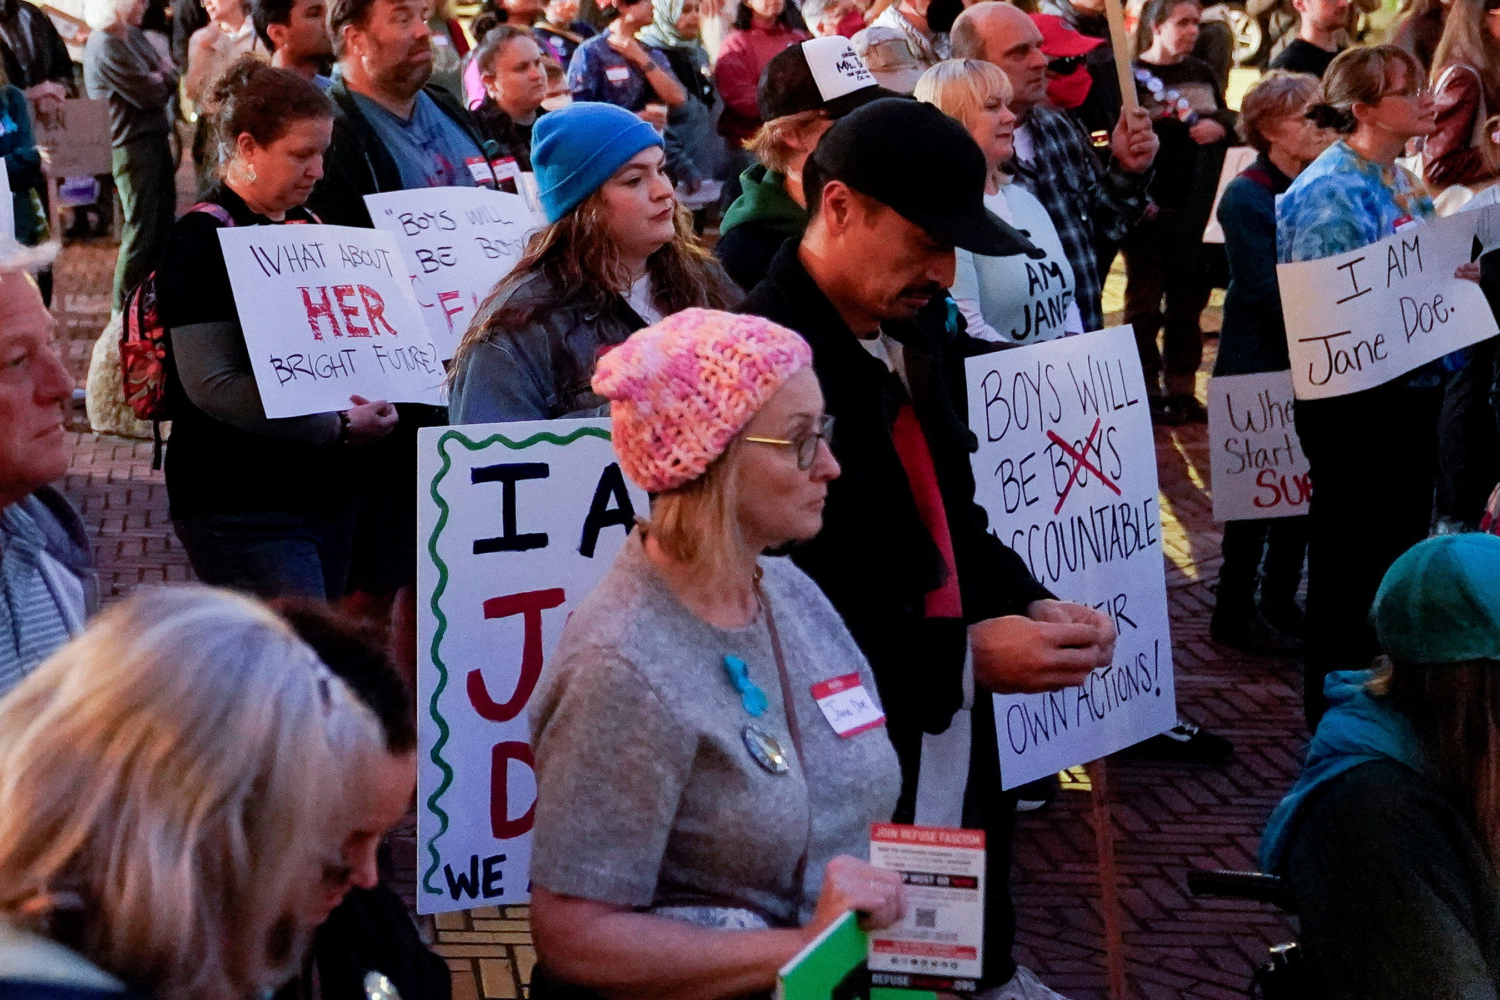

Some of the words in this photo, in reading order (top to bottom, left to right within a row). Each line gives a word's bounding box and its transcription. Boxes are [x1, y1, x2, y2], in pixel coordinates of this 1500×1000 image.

[465, 204, 514, 226] WILL
[249, 243, 326, 278] WHAT
[338, 243, 394, 278] ABOUT
[415, 246, 457, 274] BE
[1024, 261, 1067, 297] AM
[1336, 256, 1373, 304] I
[1386, 234, 1423, 288] AM
[296, 284, 398, 342] HER
[269, 348, 356, 387] BRIGHT
[1297, 331, 1389, 387] Jane
[981, 360, 1062, 442] BOYS
[1067, 354, 1139, 418] WILL
[995, 451, 1038, 515] BE
[1048, 426, 1122, 499] BOYS
[1224, 433, 1297, 475] Start
[470, 462, 550, 555] I
[1007, 691, 1068, 755] OWN
[1076, 639, 1161, 727] ACTIONS!
[443, 854, 508, 901] WE
